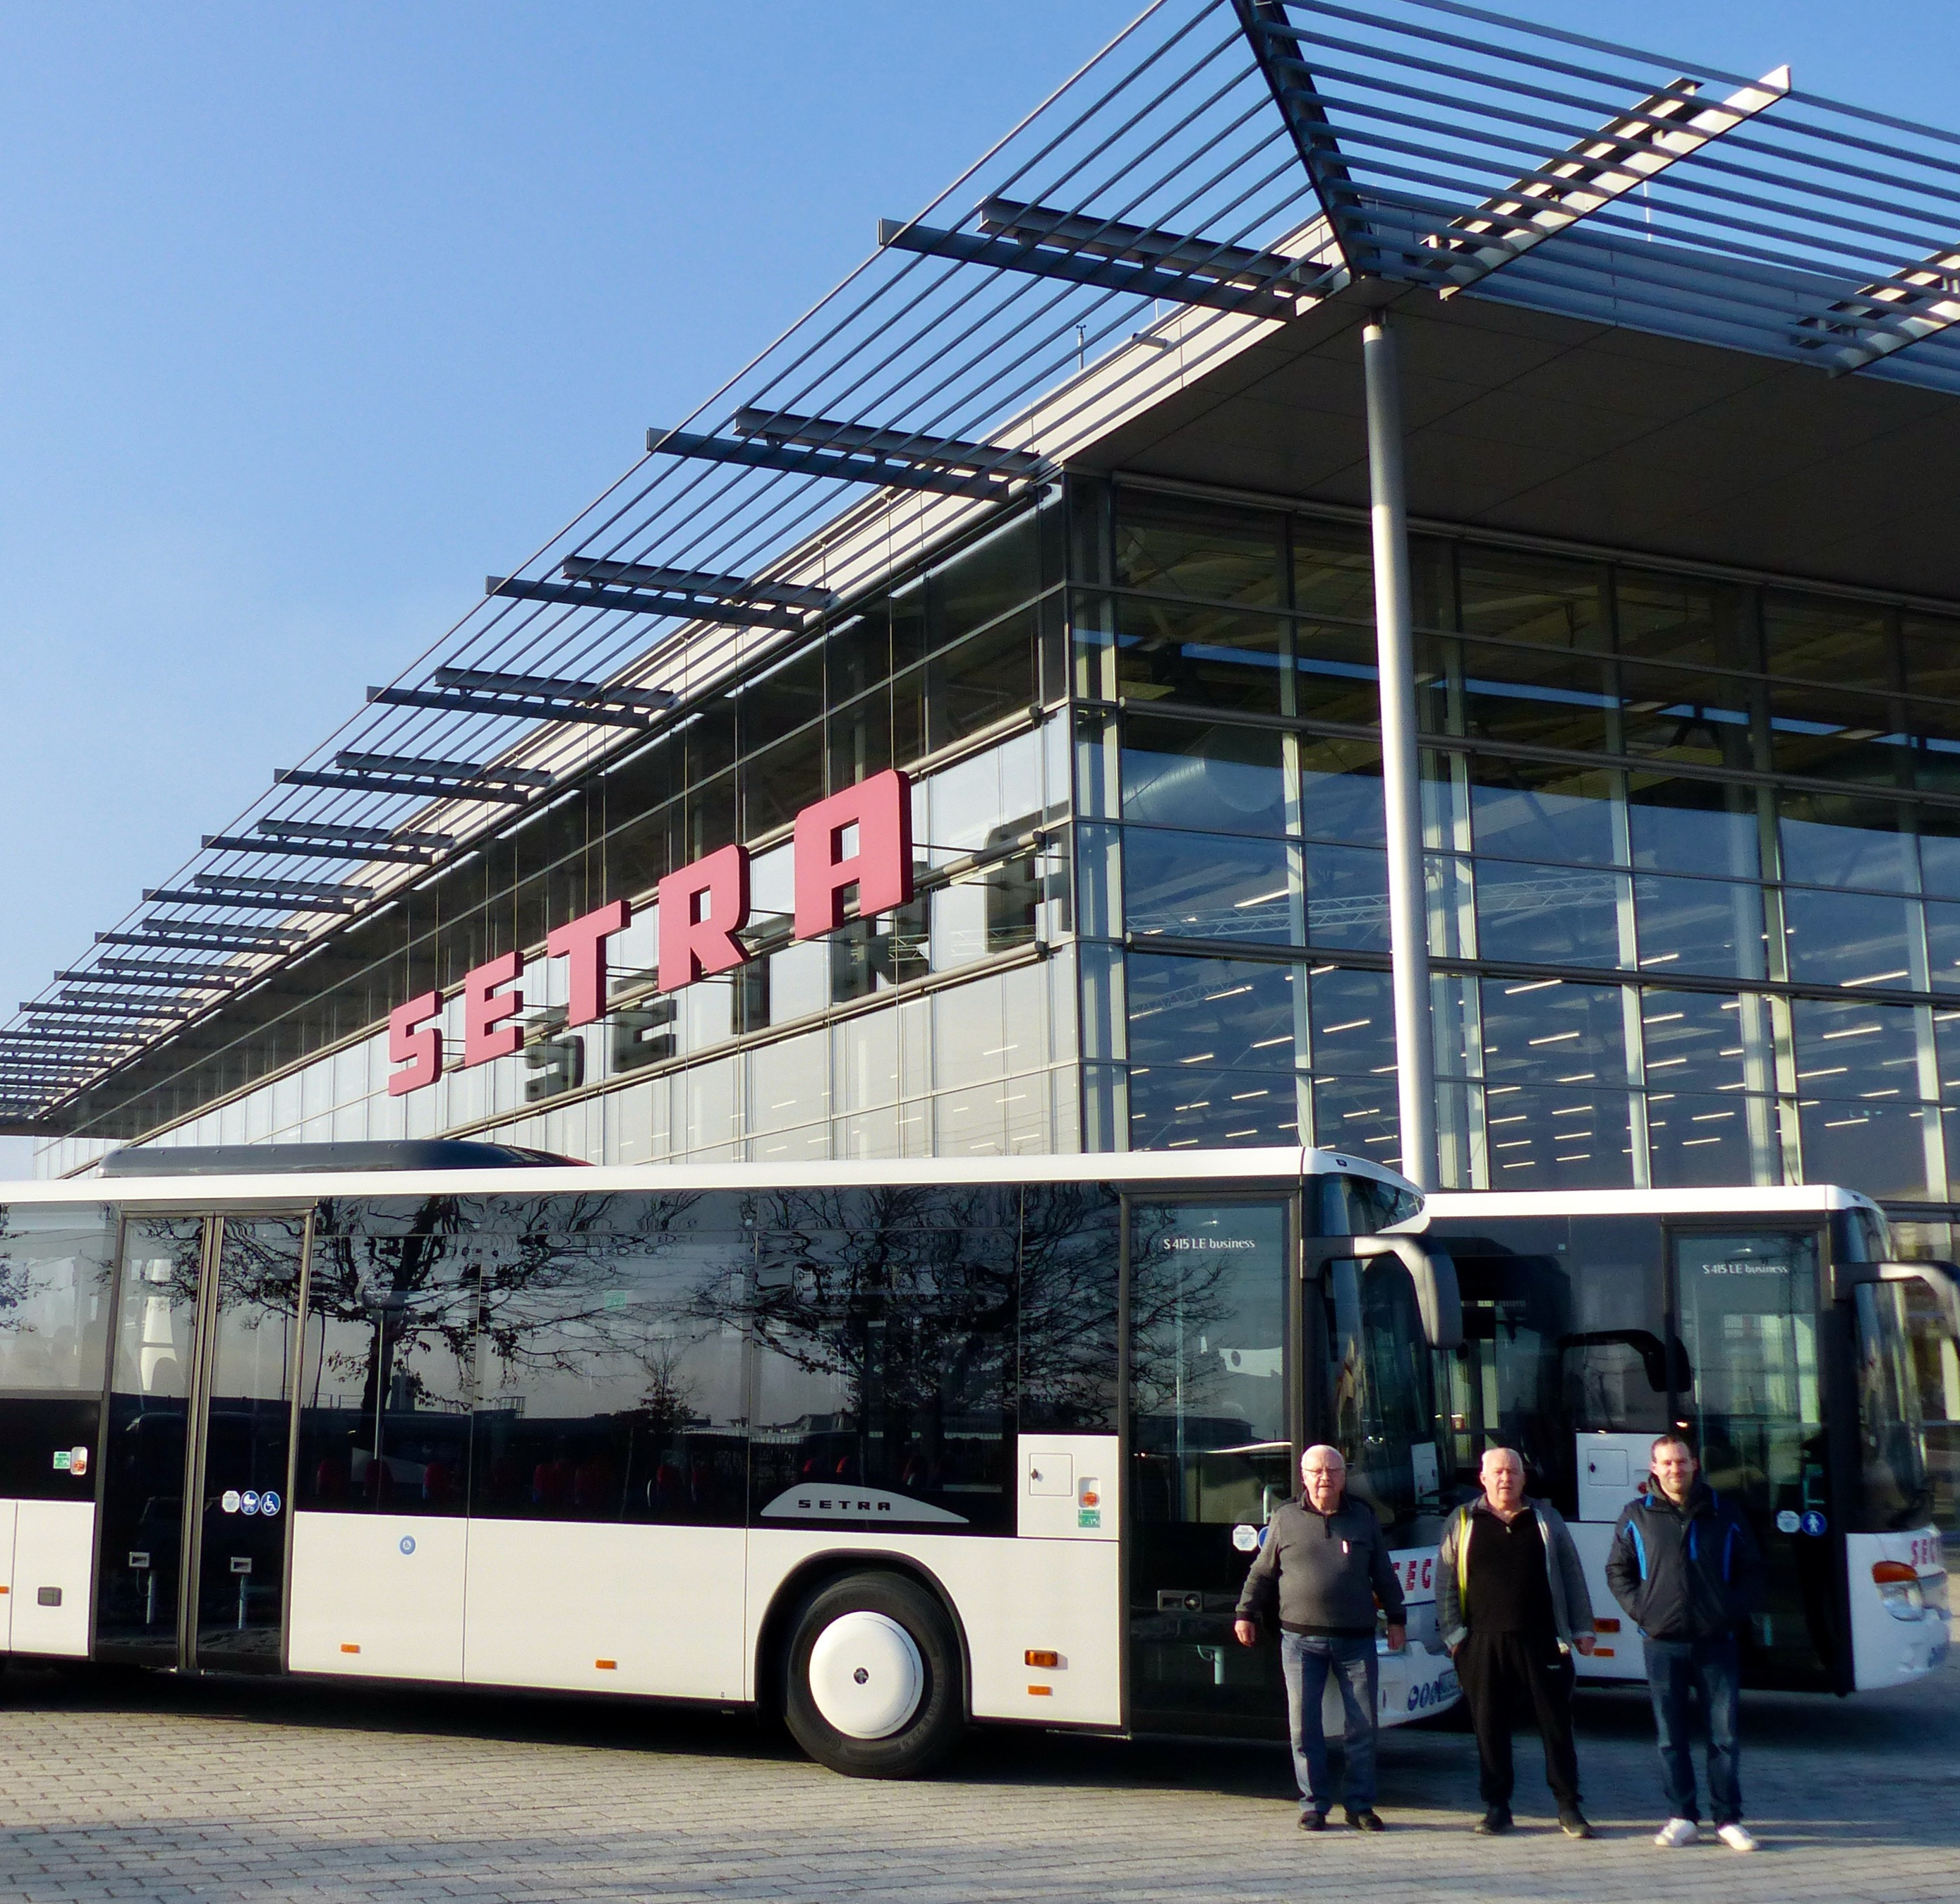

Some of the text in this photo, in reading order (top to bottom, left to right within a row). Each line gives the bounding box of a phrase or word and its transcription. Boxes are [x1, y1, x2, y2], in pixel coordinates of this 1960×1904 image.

[389, 769, 914, 1096] SETRA
[1163, 1237, 1255, 1249] S 415 LE business
[1702, 1264, 1710, 1274] S
[1729, 1264, 1743, 1274] LE
[1745, 1263, 1789, 1274] business
[798, 1499, 890, 1510] SETRA
